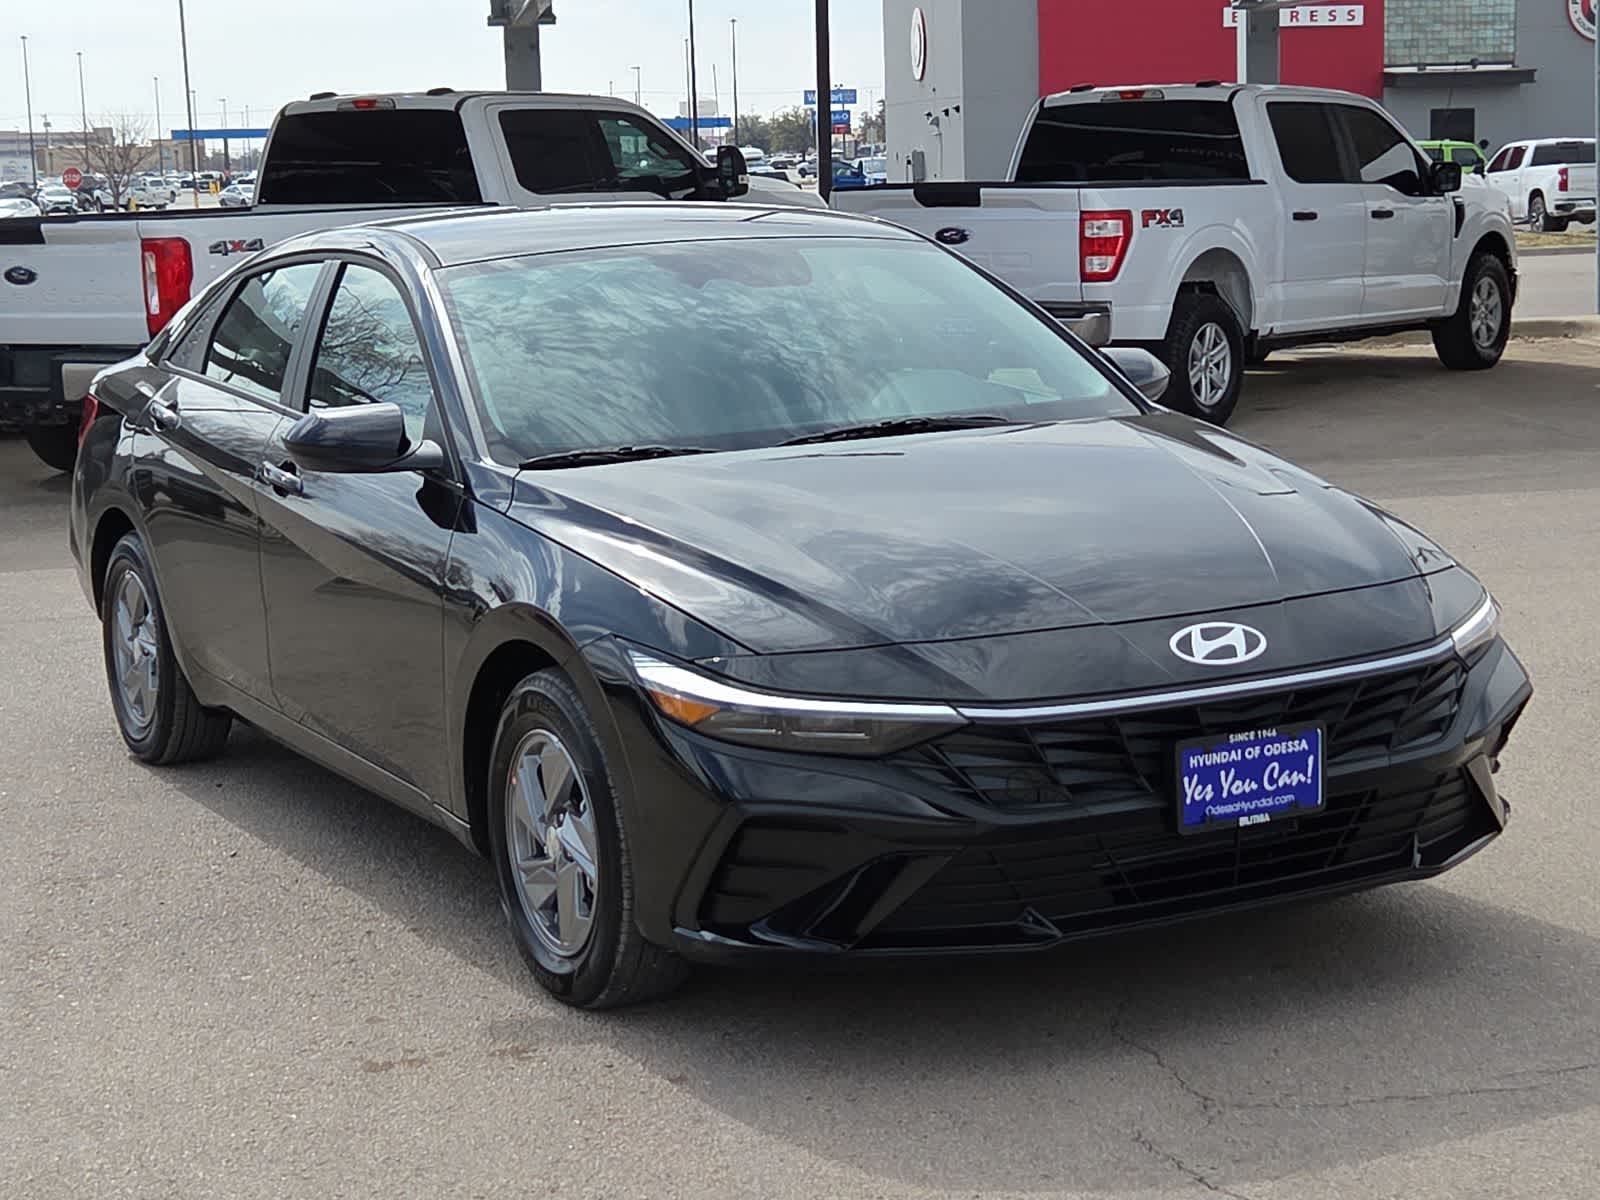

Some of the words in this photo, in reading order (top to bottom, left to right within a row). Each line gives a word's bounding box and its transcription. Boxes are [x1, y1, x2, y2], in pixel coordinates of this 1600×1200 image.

[1232, 9, 1356, 23] ERESS
[1141, 208, 1185, 228] FX4
[1229, 730, 1255, 743] SINCE
[1189, 749, 1242, 769] HYUNDAI
[1245, 746, 1260, 760] OF
[1263, 738, 1309, 757] ODESSA
[1183, 773, 1214, 805] Yes
[1220, 767, 1258, 799] You
[1263, 754, 1314, 792] Can!
